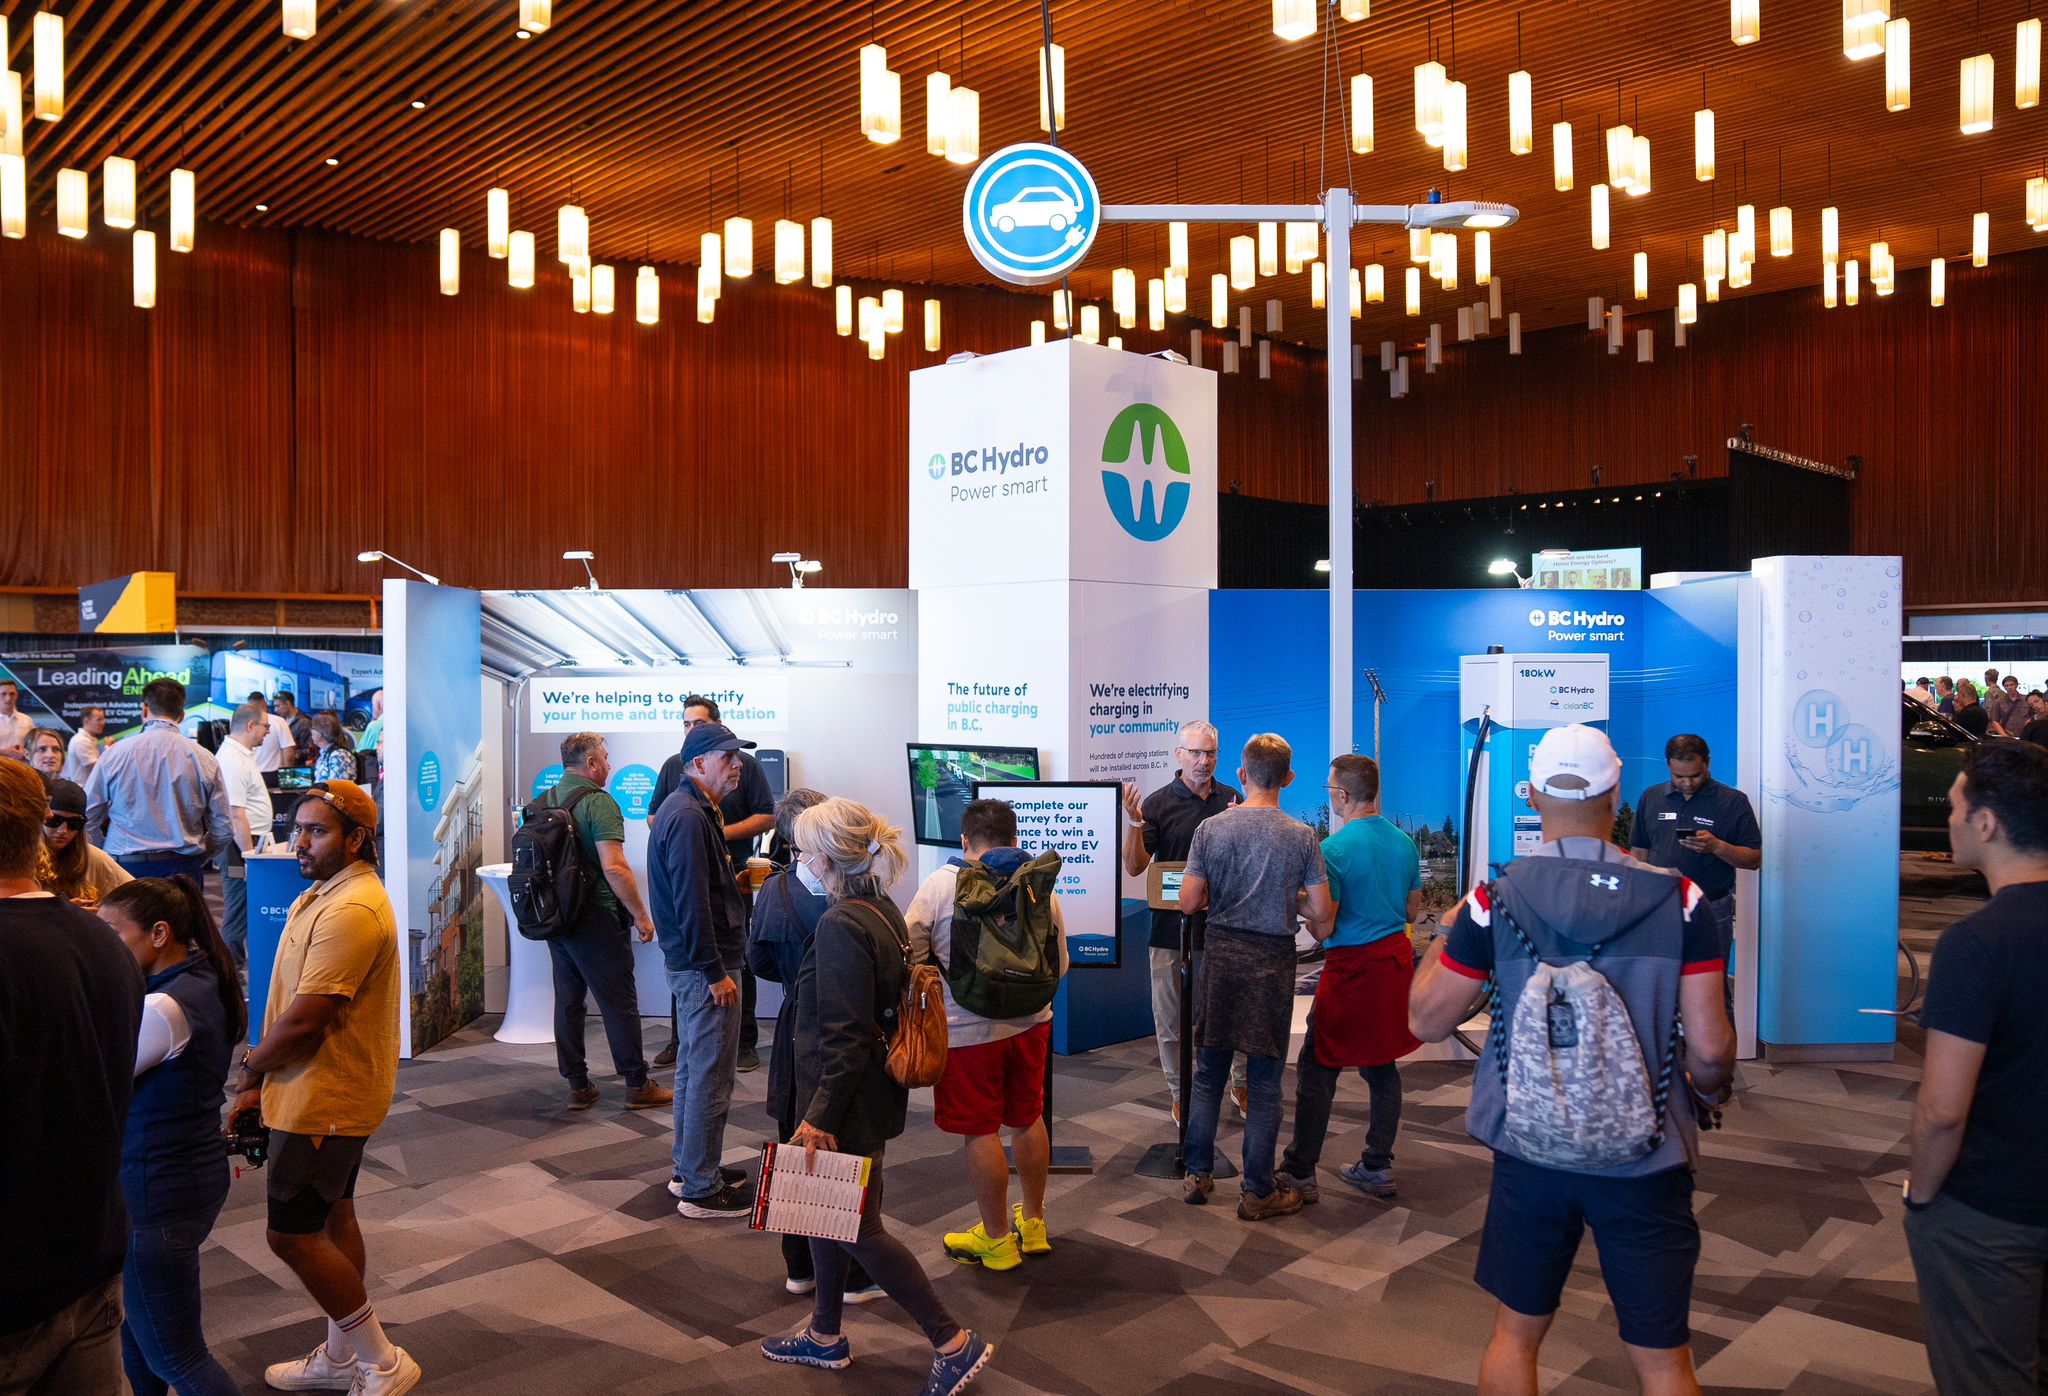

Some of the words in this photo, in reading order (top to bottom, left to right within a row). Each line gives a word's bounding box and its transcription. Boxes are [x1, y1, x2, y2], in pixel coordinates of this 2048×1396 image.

[951, 450, 978, 475] BC
[982, 442, 1048, 474] Hydro
[951, 484, 997, 502] Power
[1002, 476, 1048, 496] smart
[818, 608, 843, 624] BC
[844, 608, 899, 627] Hydro
[1548, 610, 1572, 625] BC
[1573, 610, 1625, 628] Hydro
[818, 628, 857, 640] Power
[862, 629, 898, 640] smart
[1548, 630, 1586, 641] Power
[1589, 631, 1625, 641] smart
[37, 667, 122, 689] Leading
[351, 668, 372, 676] Expert
[947, 682, 969, 695] The
[973, 682, 1010, 695] future
[1014, 683, 1028, 696] of
[1128, 682, 1189, 699] electrifying
[1570, 686, 1595, 695] Hydro
[595, 690, 651, 706] helping
[657, 692, 673, 703] to
[679, 690, 744, 705] ectrify
[116, 709, 142, 717] Chargin
[543, 709, 576, 724] your
[581, 708, 623, 721] home
[628, 708, 657, 721] and
[662, 708, 776, 721] trartation
[947, 700, 982, 715] public
[985, 700, 1038, 719] charging
[1089, 700, 1139, 719] charging
[1143, 700, 1153, 715] in
[947, 717, 957, 730] in
[961, 718, 983, 730] B.C.
[1808, 702, 1834, 738] H
[1089, 723, 1116, 738] your
[1118, 718, 1180, 735] community
[1089, 752, 1116, 760] Hundreds
[1124, 750, 1147, 759] charging
[1148, 749, 1169, 757] stations
[1842, 739, 1868, 774] H
[1089, 765, 1100, 773] will
[1100, 764, 1108, 772] be
[1109, 763, 1132, 772] installed
[1150, 761, 1162, 769] B.C.
[1163, 760, 1168, 768] in
[1008, 800, 1064, 812] Complete
[1068, 802, 1088, 810] our
[1017, 815, 1050, 825] urvey
[1054, 813, 1072, 823] for
[1014, 829, 1041, 837] ance
[1045, 827, 1058, 837] to
[1062, 827, 1083, 837] win
[1087, 829, 1094, 837] a
[1021, 840, 1037, 850] BC
[1041, 840, 1077, 850] Hydro
[1081, 840, 1099, 850] EV
[1062, 853, 1094, 864] redit.
[1062, 876, 1080, 884] 150
